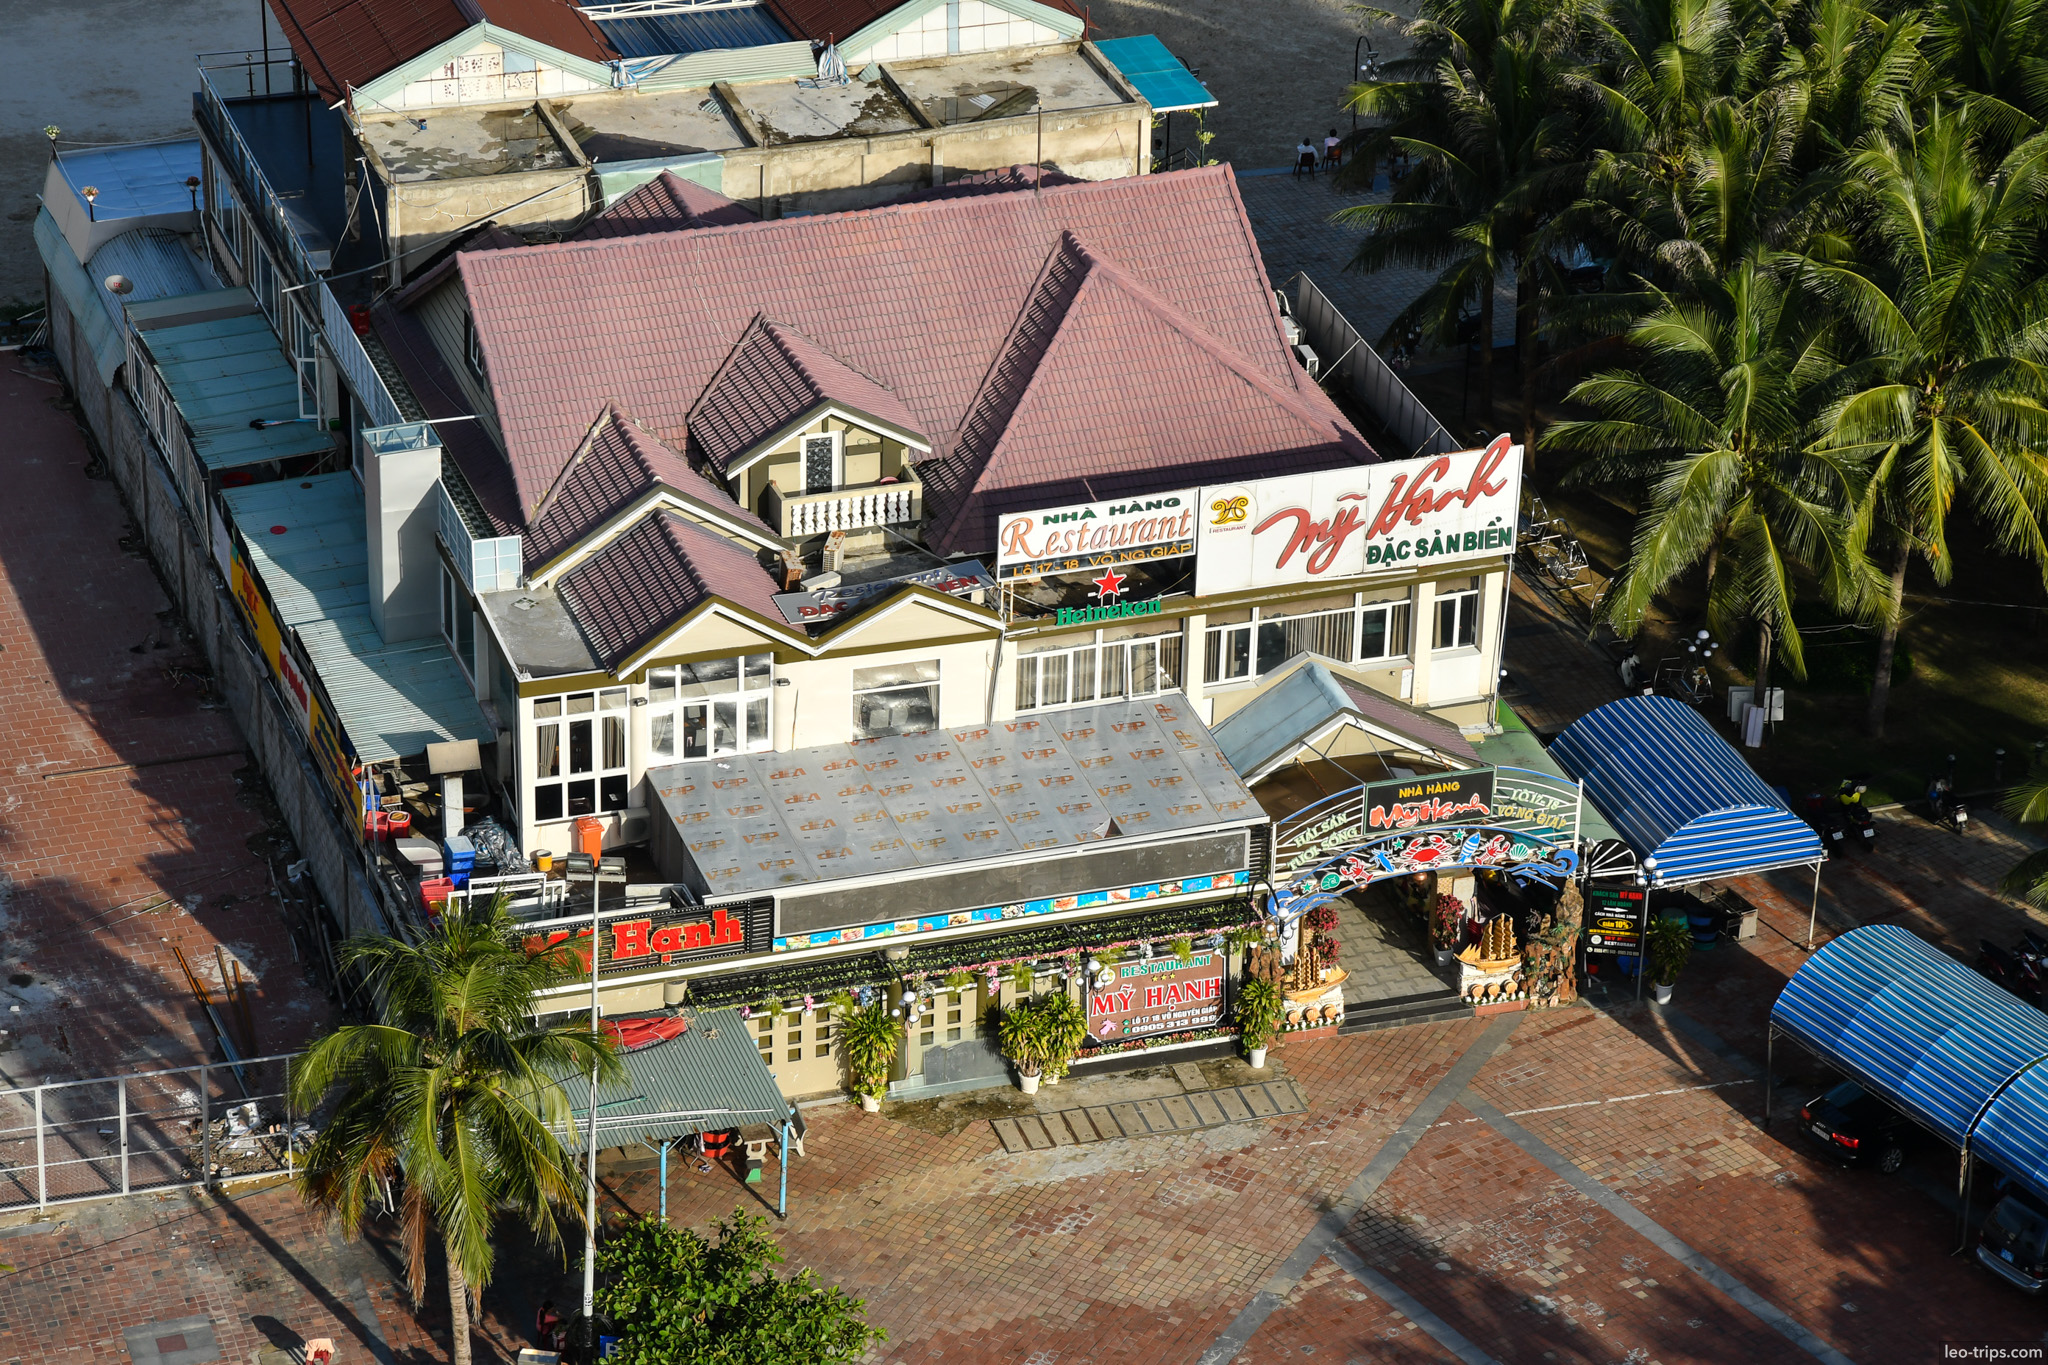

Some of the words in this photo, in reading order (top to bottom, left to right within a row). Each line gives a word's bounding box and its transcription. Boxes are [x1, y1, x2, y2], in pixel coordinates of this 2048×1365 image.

[1043, 507, 1097, 525] NHÀ
[1109, 497, 1181, 516] HÀNG
[1001, 508, 1192, 558] Restaurant
[1366, 536, 1411, 566] ĐẶC
[1415, 529, 1460, 558] SẢN
[1056, 599, 1162, 626] Heineken
[1399, 784, 1423, 798] NHÀ
[1426, 781, 1460, 795] HÀNG
[1615, 921, 1629, 929] 10%
[1090, 983, 1137, 1017] MỸ
[1145, 976, 1222, 1012] HẠNH
